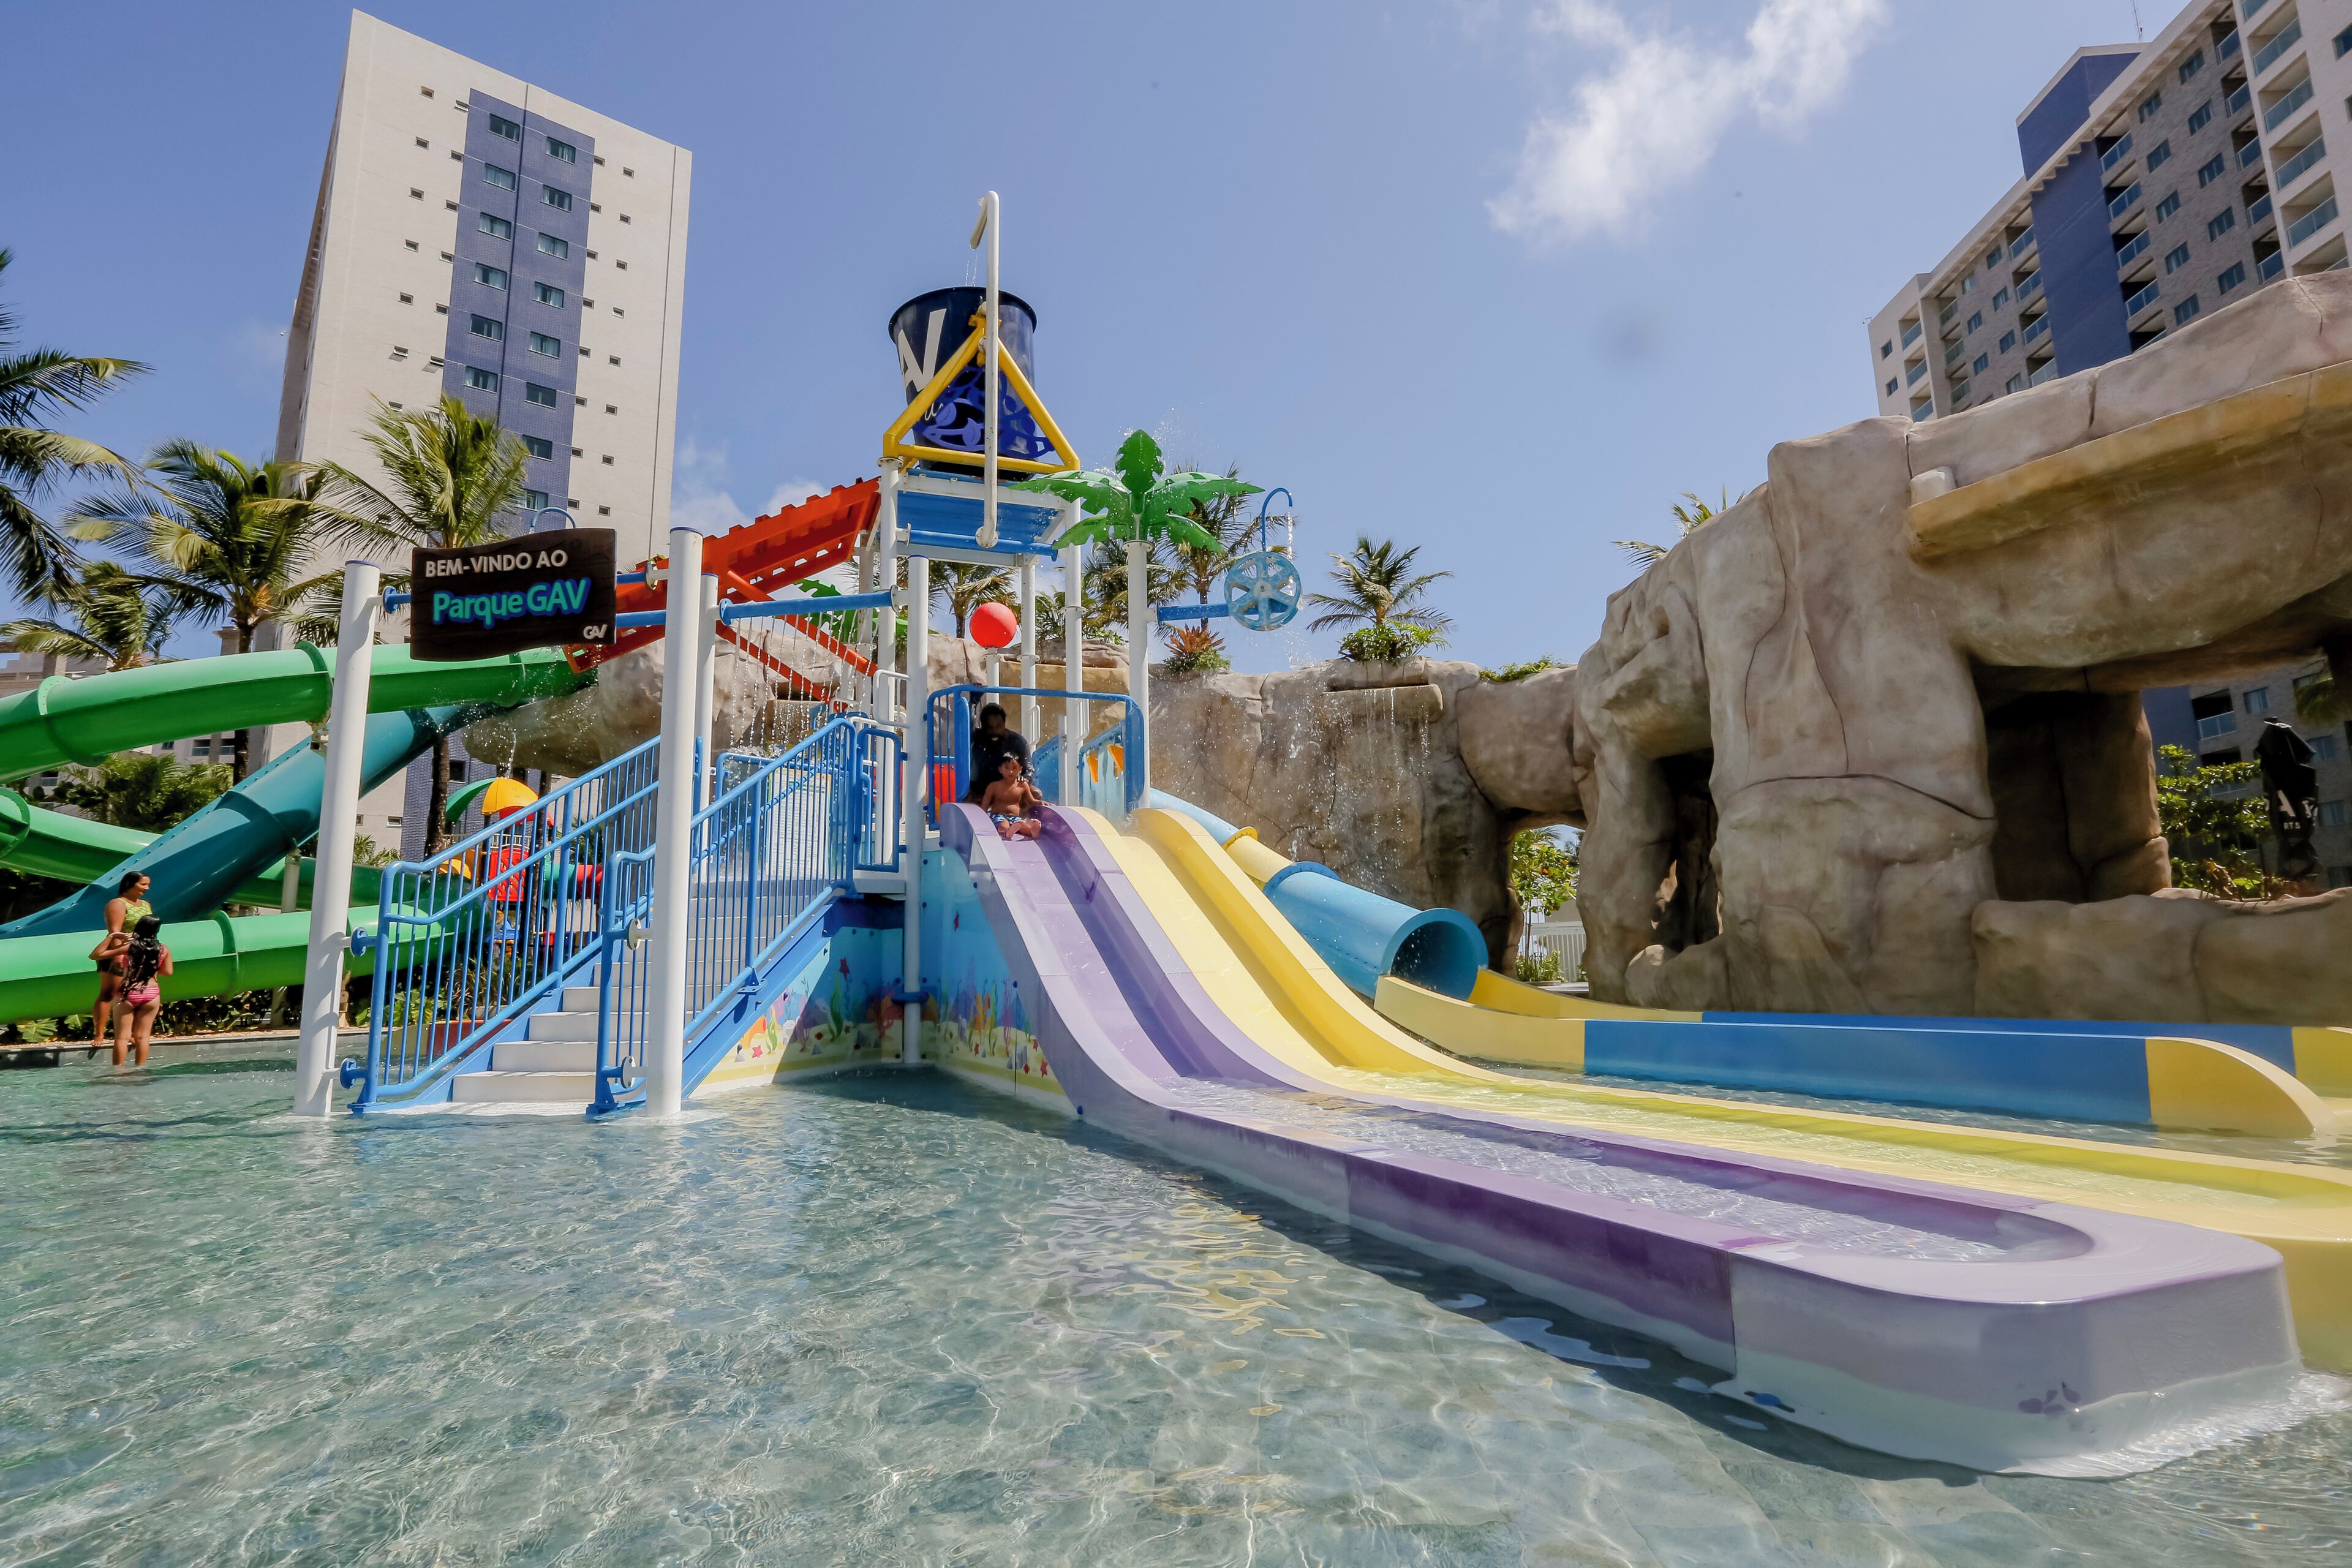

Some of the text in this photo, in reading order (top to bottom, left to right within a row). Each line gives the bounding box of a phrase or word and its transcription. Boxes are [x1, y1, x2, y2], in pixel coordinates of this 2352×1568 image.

[425, 549, 568, 578] BEM-VINDO AO
[433, 578, 589, 627] Parque GAV
[582, 624, 608, 640] GAV
